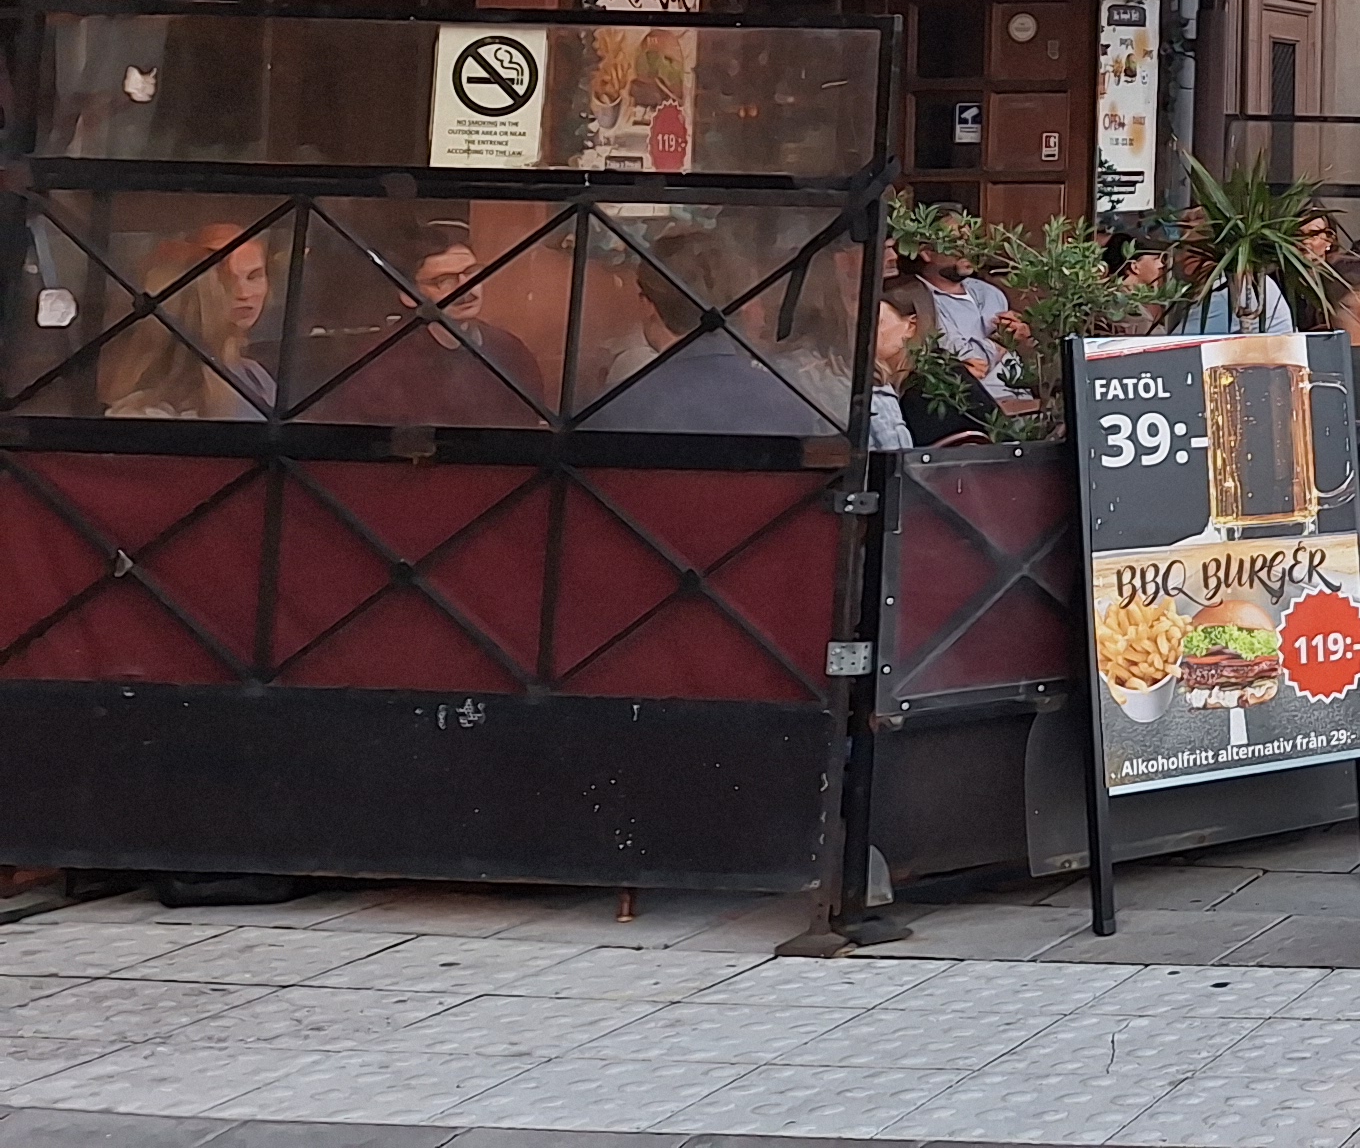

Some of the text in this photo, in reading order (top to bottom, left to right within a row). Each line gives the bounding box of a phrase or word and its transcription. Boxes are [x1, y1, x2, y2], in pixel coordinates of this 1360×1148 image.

[1094, 371, 1171, 401] FATÖL
[1099, 412, 1209, 469] 39:-
[1115, 541, 1342, 609] BBQ BURGER
[1120, 728, 1357, 778] Alkoholfritt alternativ från 29:-
